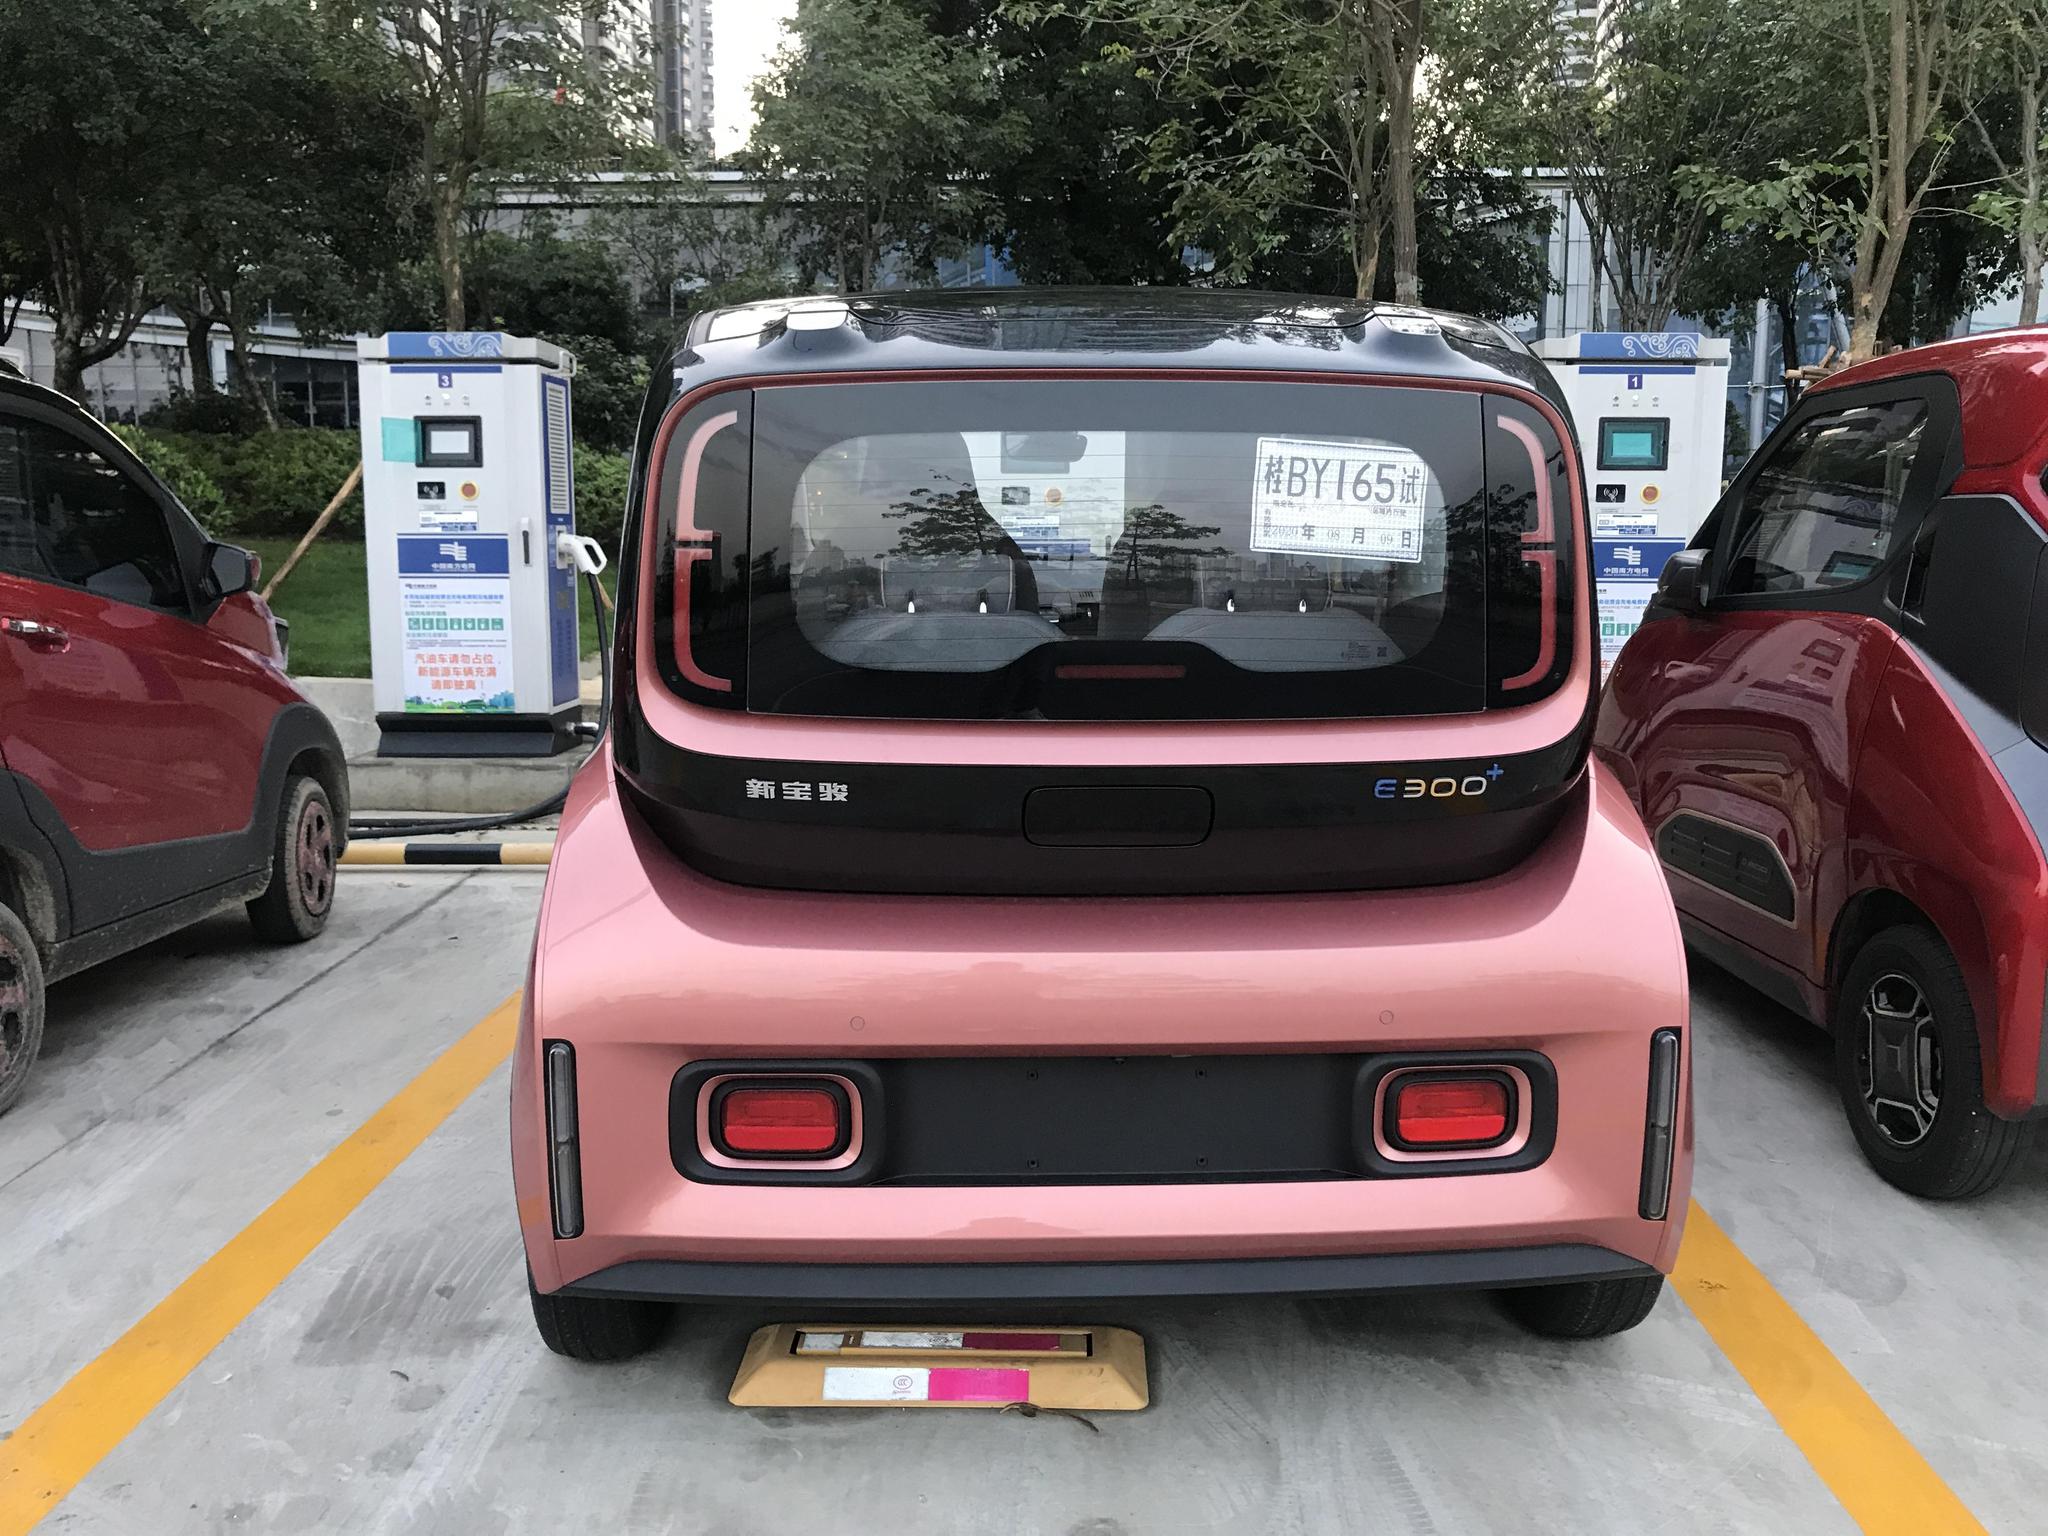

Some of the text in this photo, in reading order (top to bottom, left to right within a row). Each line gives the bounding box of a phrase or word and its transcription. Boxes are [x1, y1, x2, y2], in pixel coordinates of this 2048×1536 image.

[442, 375, 450, 387] 3
[1632, 376, 1639, 388] 1
[745, 778, 849, 802] 新宝骏
